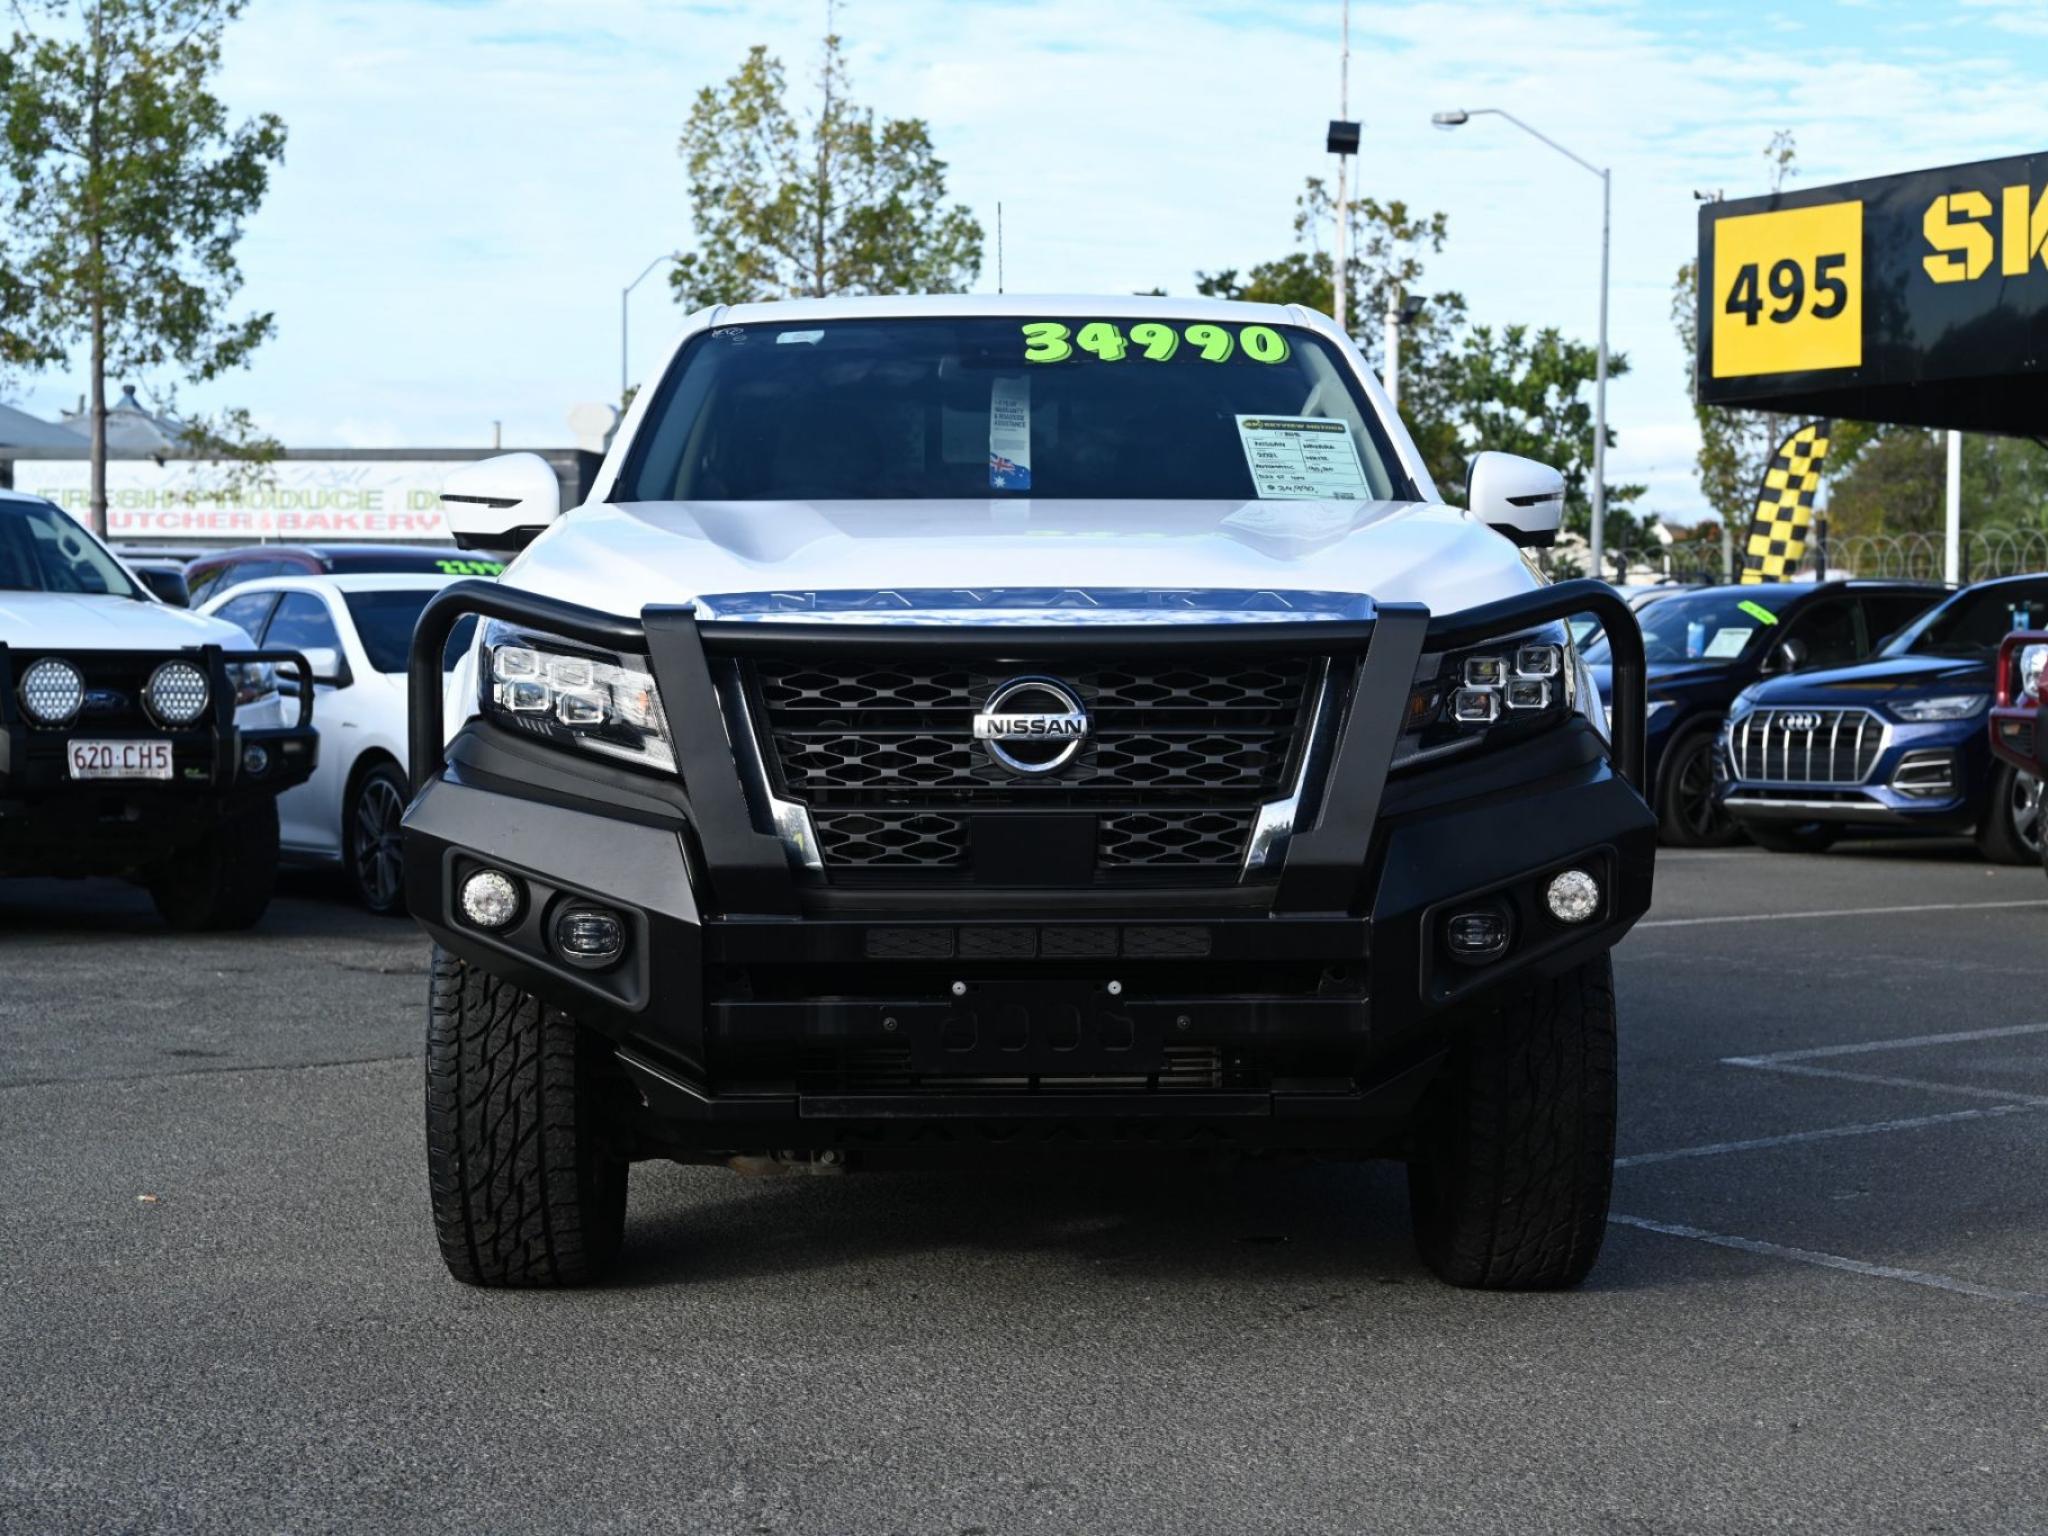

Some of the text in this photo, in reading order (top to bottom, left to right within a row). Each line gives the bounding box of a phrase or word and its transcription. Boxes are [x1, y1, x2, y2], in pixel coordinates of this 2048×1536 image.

[1725, 252, 1848, 326] 495
[1022, 322, 1291, 364] 34990
[37, 488, 173, 509] FRSH
[278, 512, 441, 530] BAKERY
[987, 719, 1081, 734] NISSAN
